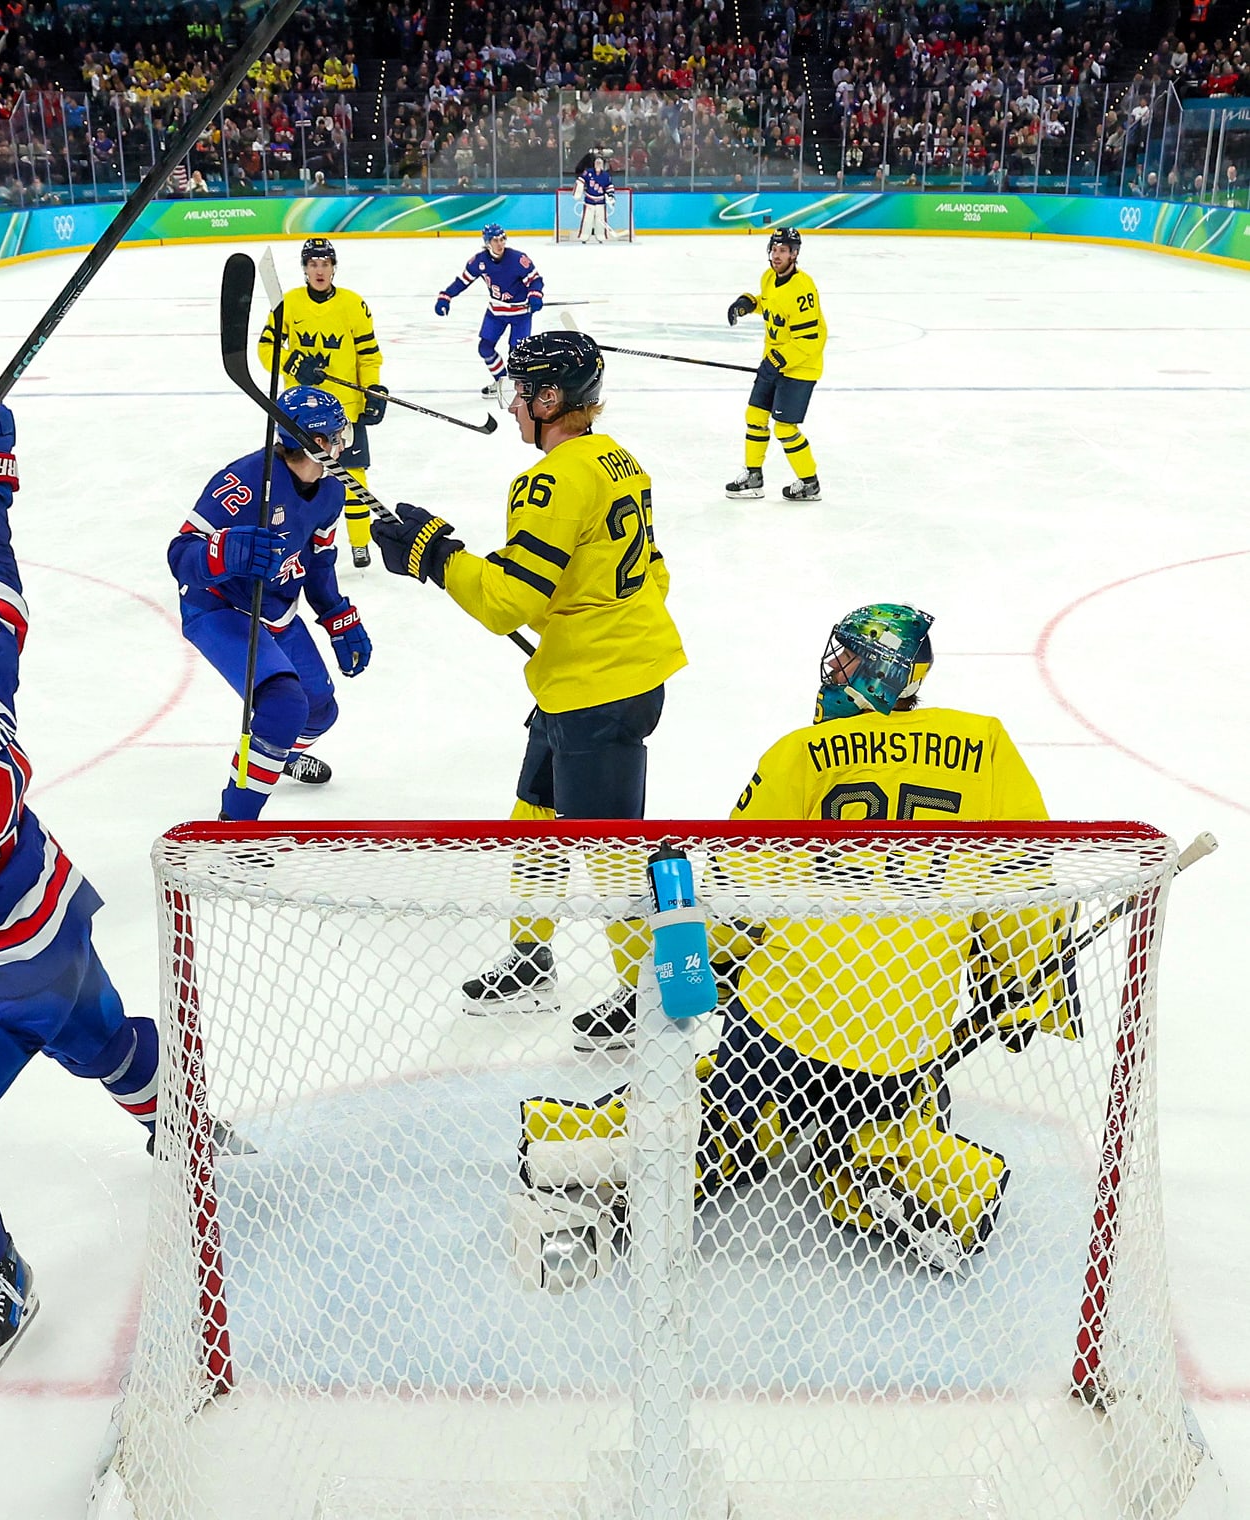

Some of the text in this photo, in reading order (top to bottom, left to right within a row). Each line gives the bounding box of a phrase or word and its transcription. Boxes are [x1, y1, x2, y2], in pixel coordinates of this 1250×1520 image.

[184, 208, 256, 220] MILANO CORTINA
[935, 203, 1009, 213] MILANO CORTINA
[211, 218, 229, 227] 2026
[963, 212, 981, 221] 2026
[797, 292, 815, 313] 28
[307, 420, 327, 430] CCM
[212, 472, 252, 516] 72
[510, 473, 556, 514] 26
[808, 731, 984, 774] MARKSTROM
[655, 962, 673, 973] OWER
[195, 1083, 210, 1145] CORINA
